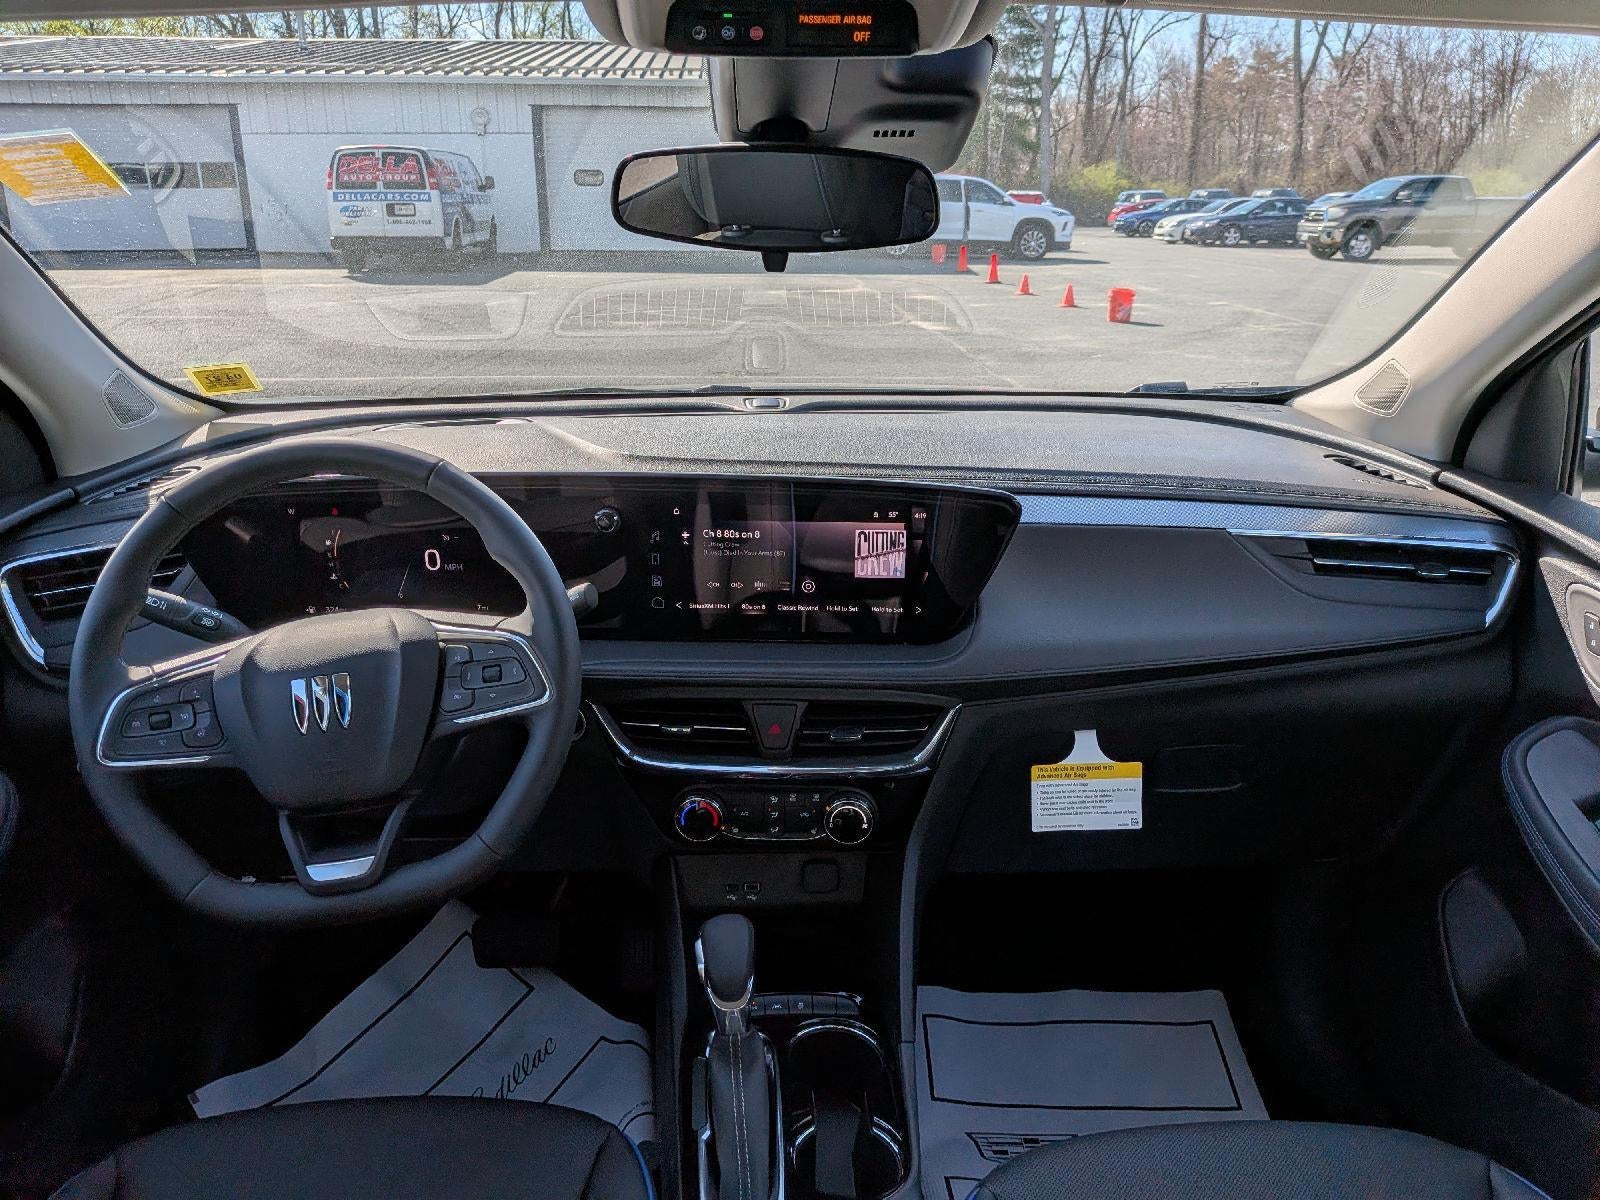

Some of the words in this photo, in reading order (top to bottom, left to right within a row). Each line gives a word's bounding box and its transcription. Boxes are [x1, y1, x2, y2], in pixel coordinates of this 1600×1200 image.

[799, 15, 842, 25] PASSENGER
[843, 15, 856, 25] AIR
[857, 15, 872, 25] BAG
[853, 31, 872, 42] OFF
[339, 155, 420, 174] DELLA
[343, 174, 373, 182] AUTO
[378, 173, 418, 182] GROUP
[337, 193, 429, 202] DELLACARS.COM
[702, 529, 715, 539] Ch
[716, 529, 722, 539] 8
[723, 529, 740, 539] 80s
[741, 531, 753, 539] on
[754, 530, 761, 539] 8
[857, 530, 905, 556] CUTTING
[424, 548, 441, 571] 0
[444, 563, 464, 571] MPH
[777, 603, 797, 611] Classic
[797, 603, 819, 611] Rewind
